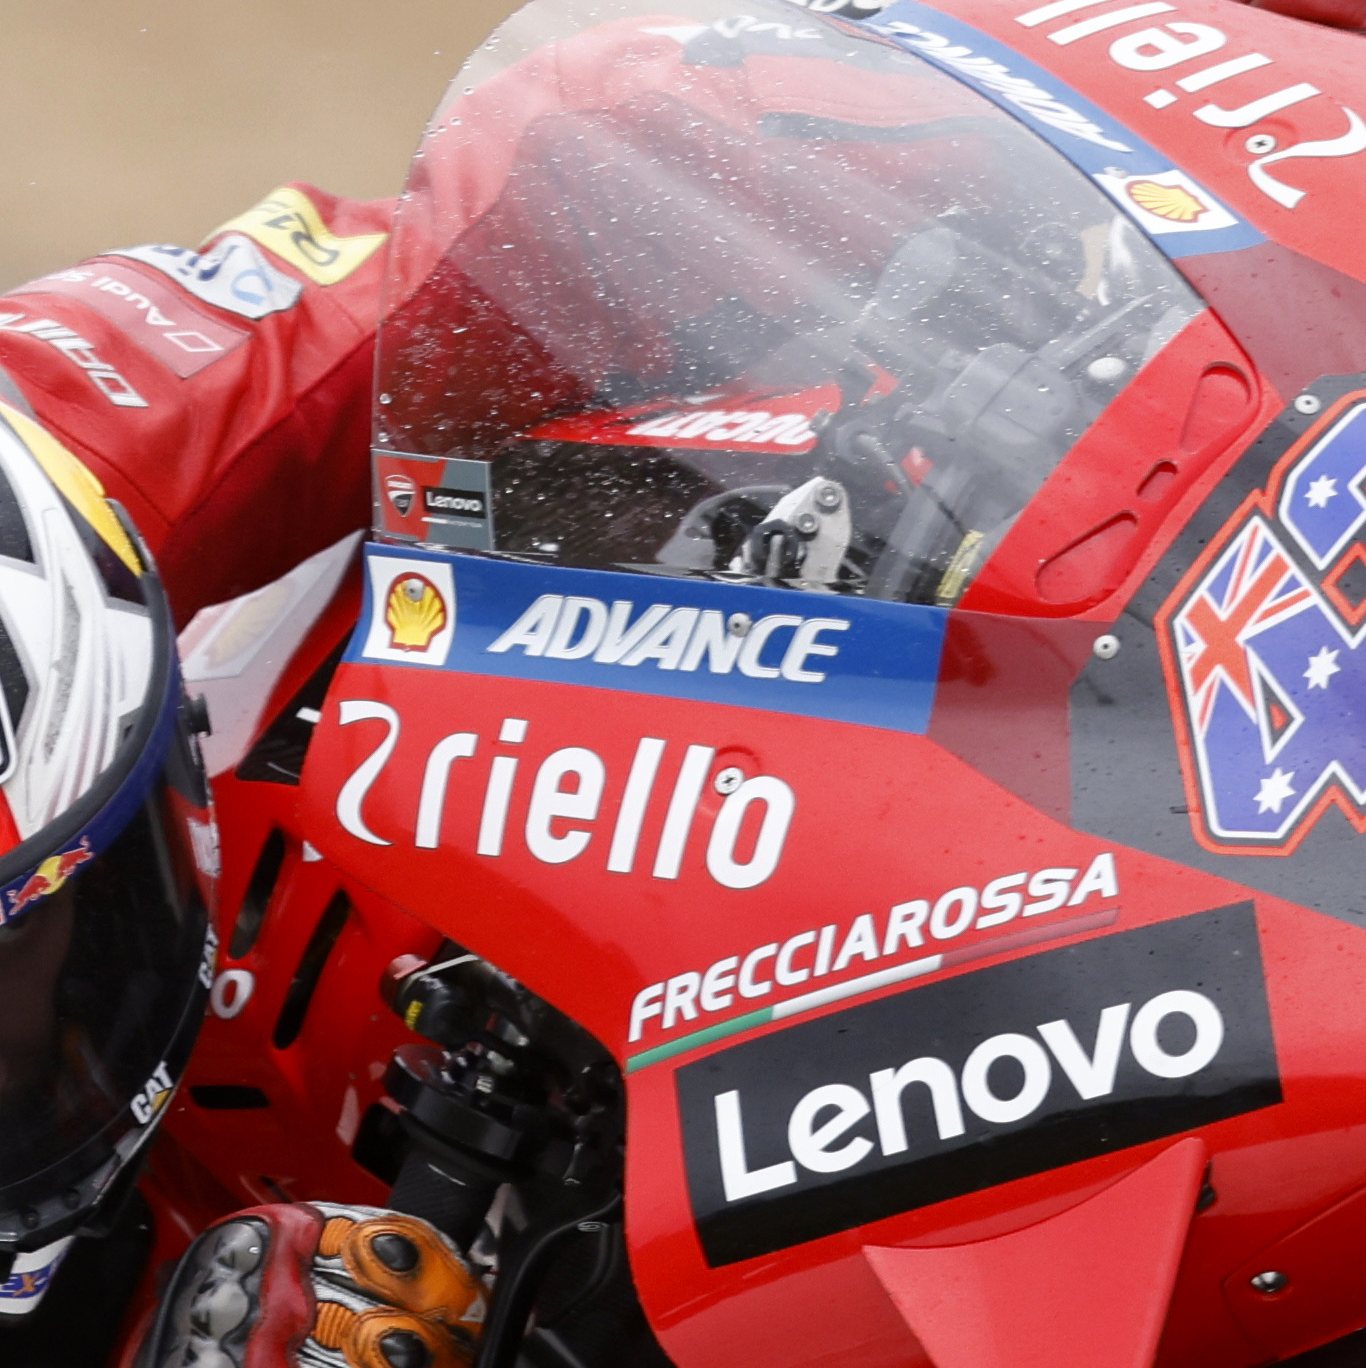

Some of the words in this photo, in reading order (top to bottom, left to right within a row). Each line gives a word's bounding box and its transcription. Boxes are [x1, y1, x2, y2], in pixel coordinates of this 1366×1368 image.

[488, 594, 850, 683] ADVANCE
[627, 852, 1119, 1043] FRECCIAROSSA
[130, 1060, 175, 1125] CAT
[713, 989, 1225, 1203] Lenovo
